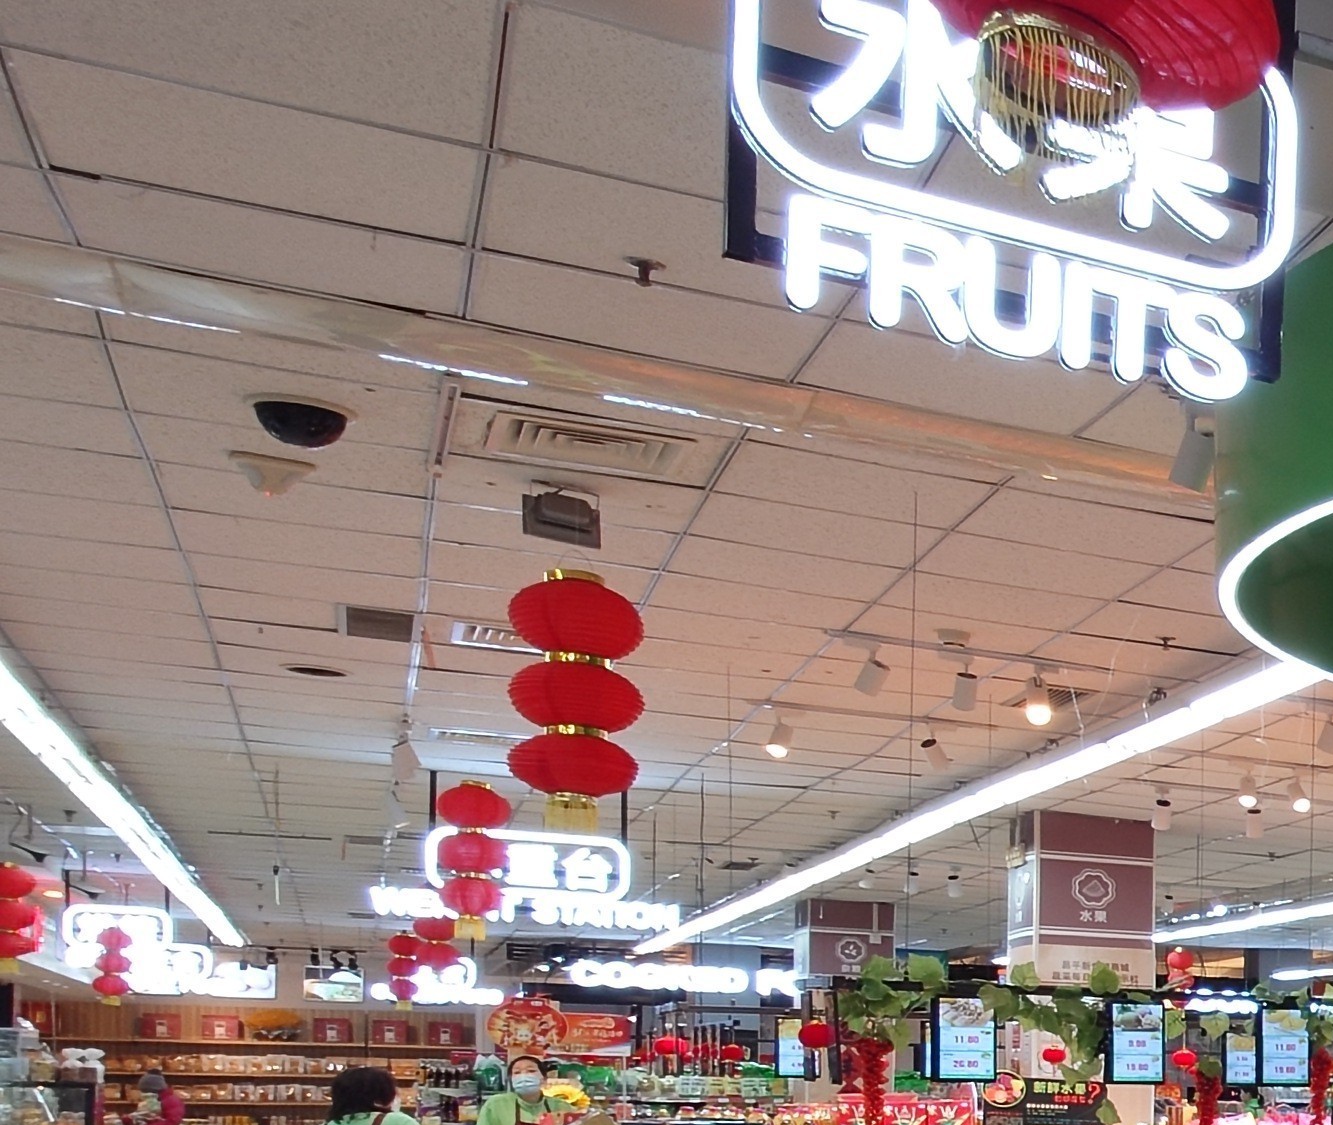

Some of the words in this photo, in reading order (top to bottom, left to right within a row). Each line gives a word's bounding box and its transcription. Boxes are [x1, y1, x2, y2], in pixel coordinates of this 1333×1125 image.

[786, 195, 1248, 403] FRUITS
[531, 902, 681, 932] STATION
[1079, 910, 1107, 923] 水果
[571, 960, 750, 994] COOKED
